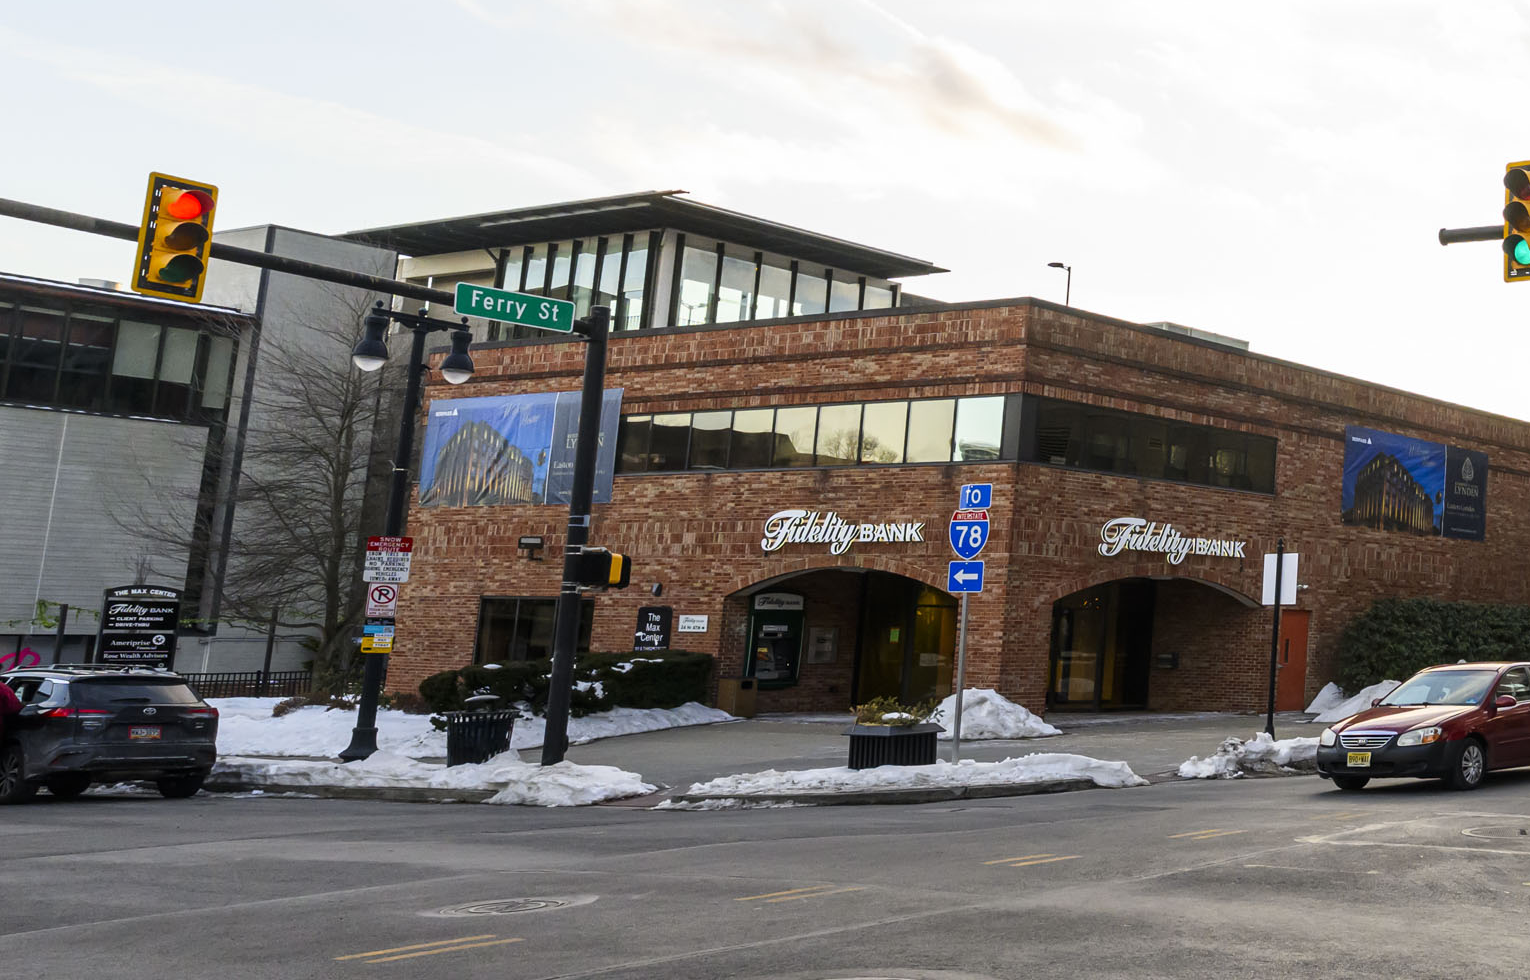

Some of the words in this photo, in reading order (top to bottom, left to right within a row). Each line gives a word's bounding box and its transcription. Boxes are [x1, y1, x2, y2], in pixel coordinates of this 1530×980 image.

[472, 290, 527, 319] Ferry
[539, 302, 560, 321] St
[966, 489, 981, 504] TO
[761, 510, 859, 555] Fidelity
[860, 522, 925, 542] BANK
[956, 525, 981, 548] 78
[1098, 517, 1192, 565] Fidelity
[1195, 538, 1246, 558] BANK
[150, 589, 176, 598] CENTER
[109, 604, 148, 616] Fidelity
[648, 613, 661, 622] The
[646, 623, 660, 631] Max
